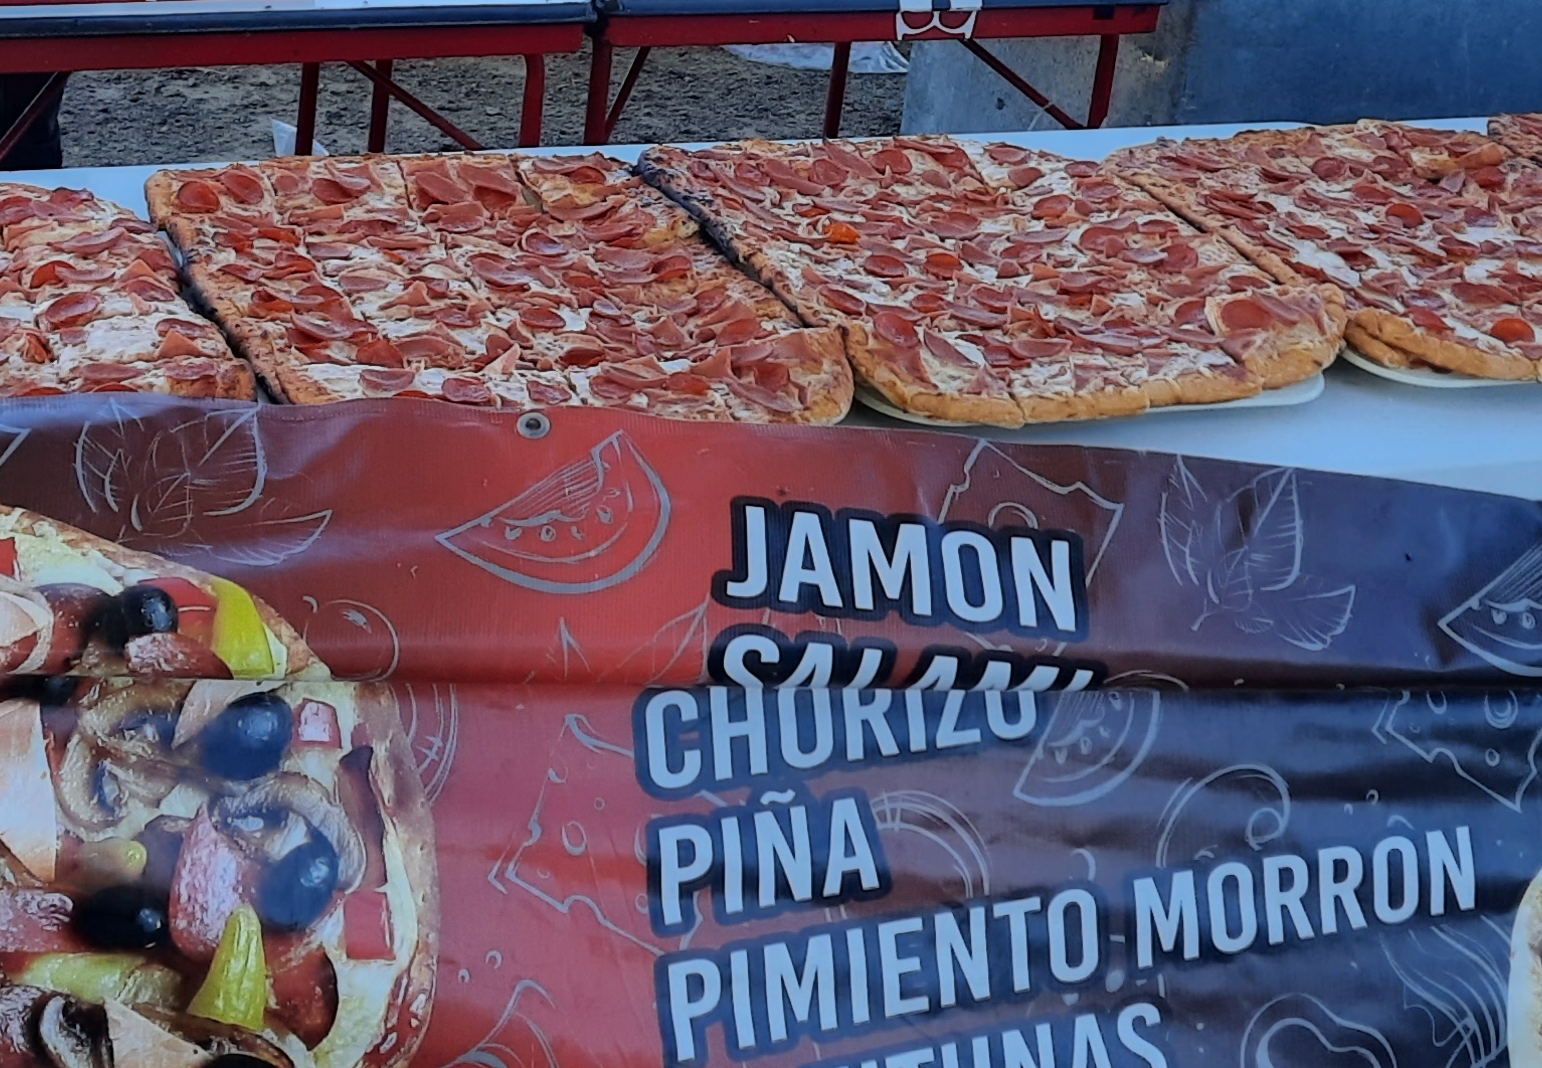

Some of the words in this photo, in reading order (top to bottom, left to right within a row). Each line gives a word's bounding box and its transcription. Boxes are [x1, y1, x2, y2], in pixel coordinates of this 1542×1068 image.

[726, 506, 1077, 632] JAMON
[645, 687, 1038, 789] CHORIZO
[659, 789, 880, 925] PIÑA
[667, 888, 1100, 1062] PIMIENTO
